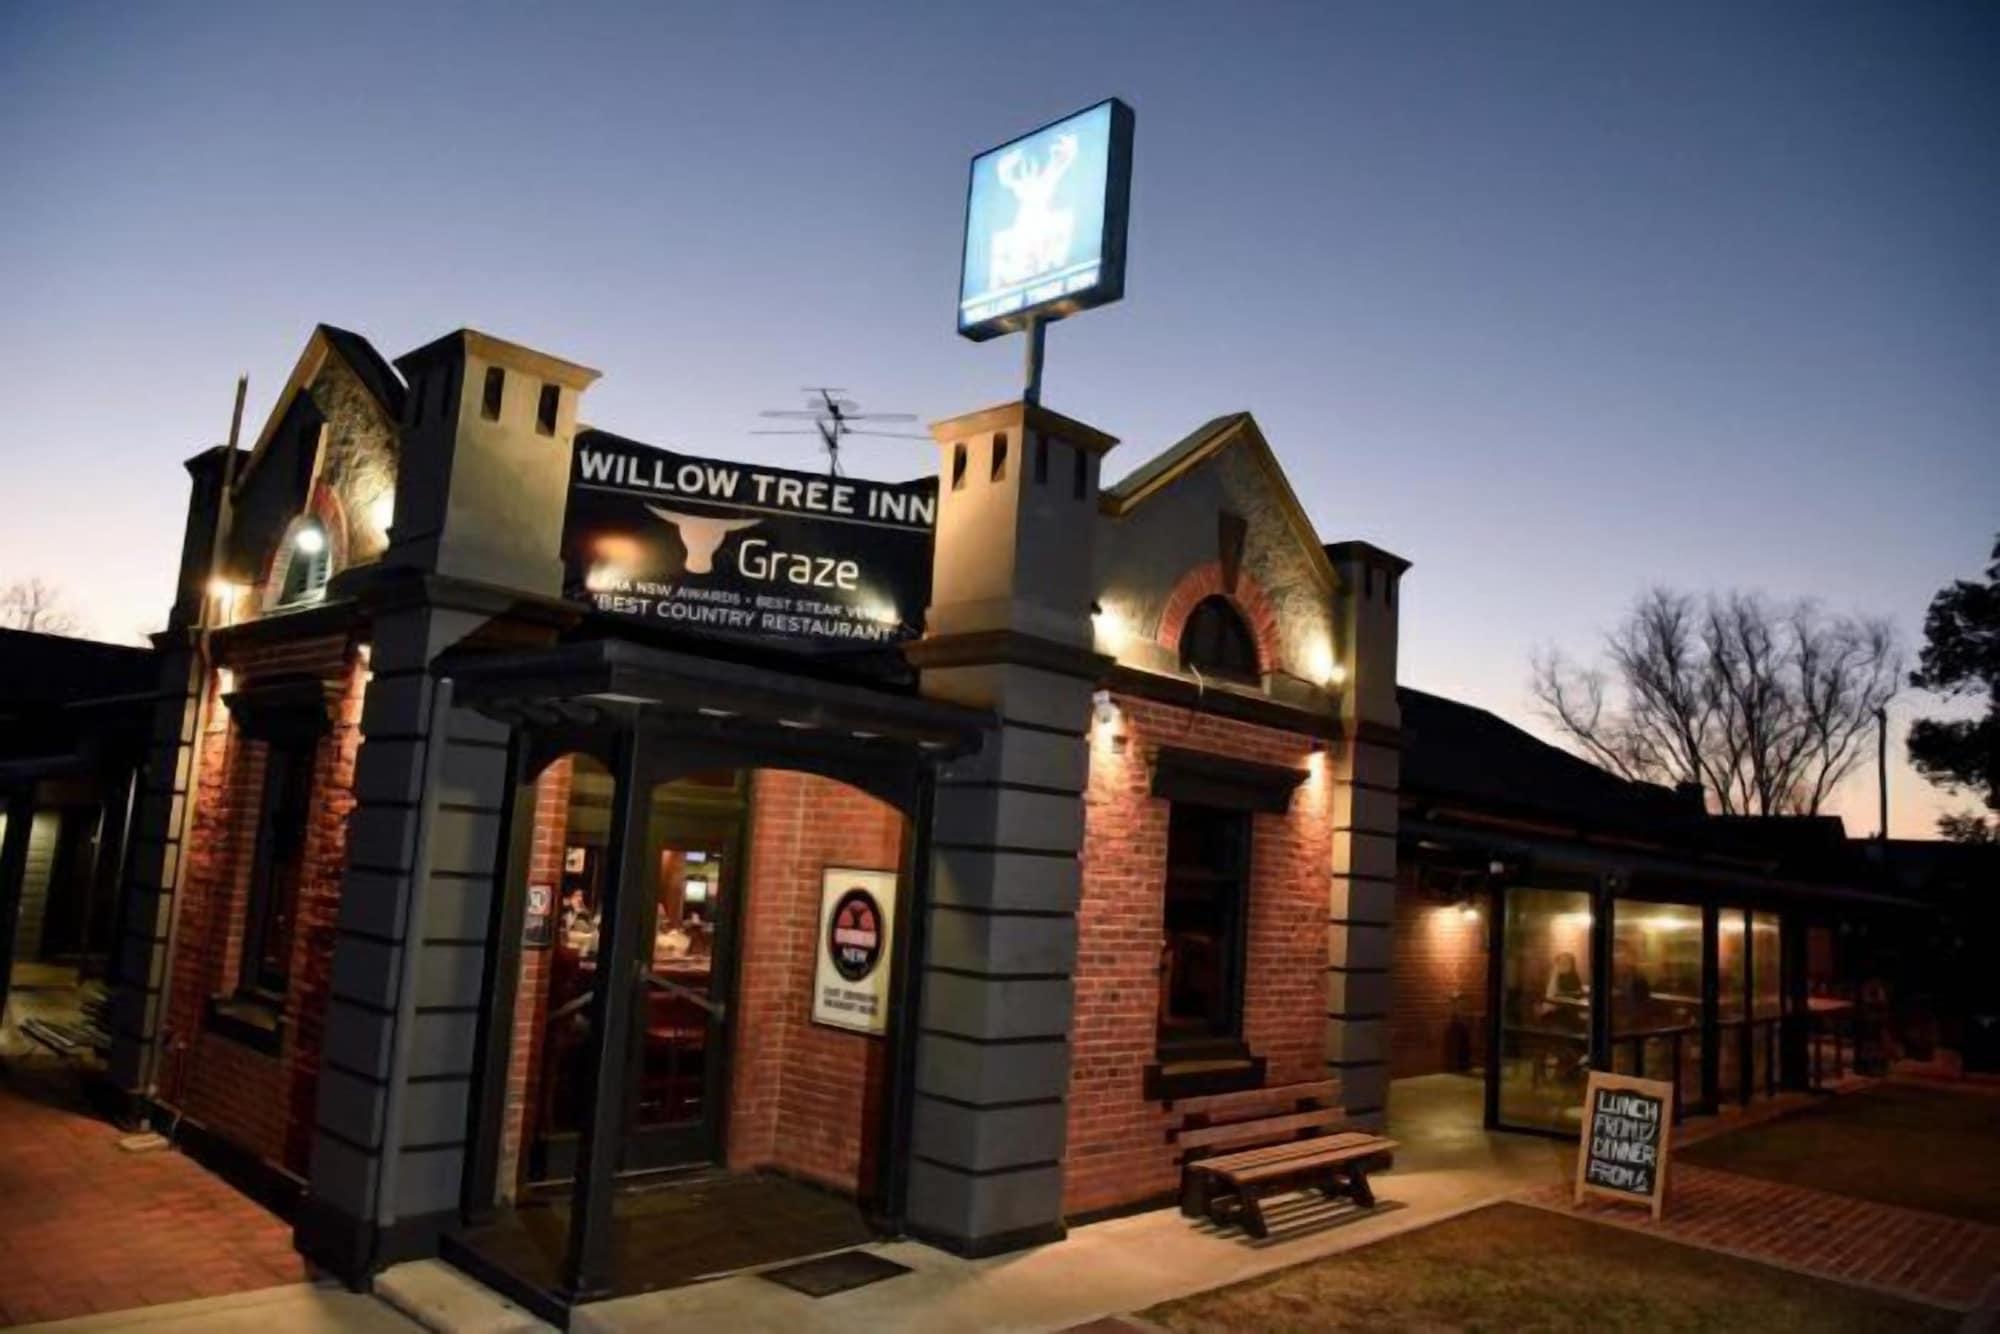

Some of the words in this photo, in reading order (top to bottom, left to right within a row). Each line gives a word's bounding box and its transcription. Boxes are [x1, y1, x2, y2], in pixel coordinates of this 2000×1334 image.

[580, 450, 738, 498] WILLOW
[751, 472, 855, 514] TREE
[869, 490, 935, 524] INN
[738, 539, 859, 590] Graze
[636, 581, 672, 596] NSW
[657, 601, 755, 627] COUNTRY
[1599, 1091, 1658, 1122] LUNCH
[1592, 1137, 1657, 1166] DINNER
